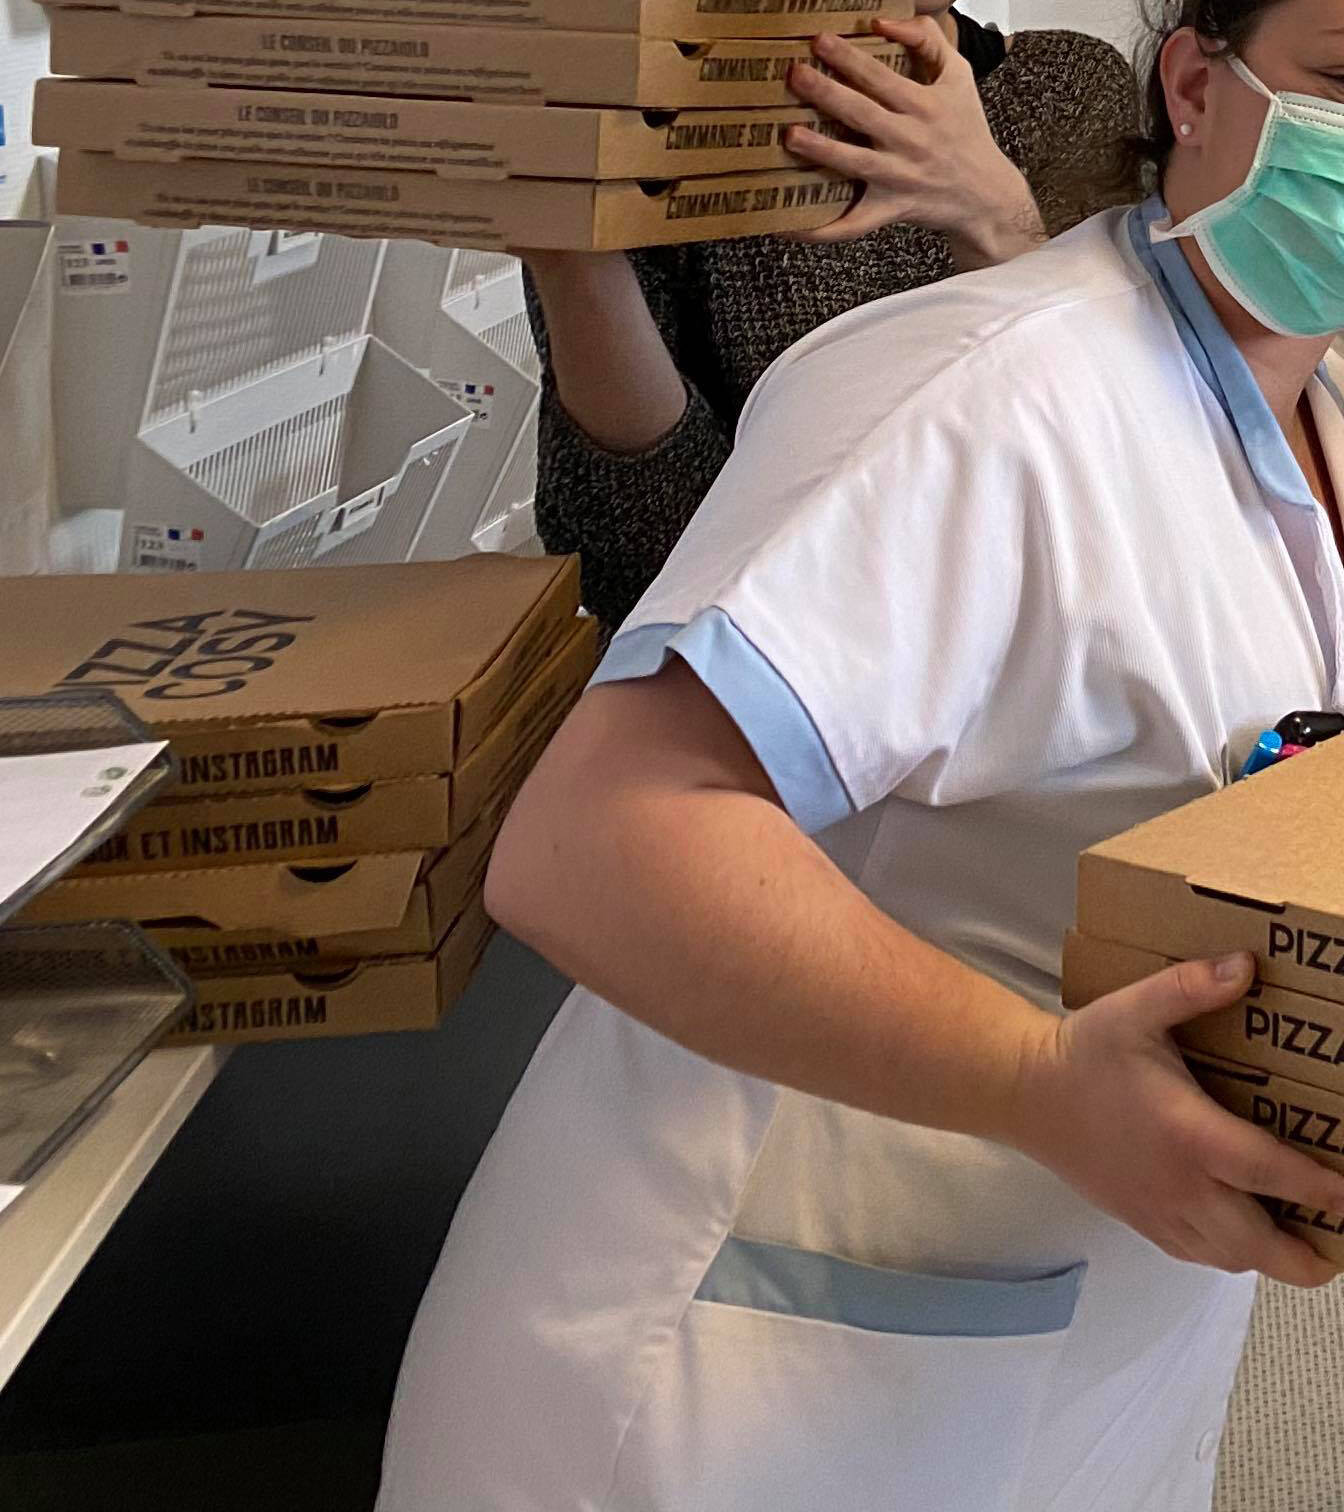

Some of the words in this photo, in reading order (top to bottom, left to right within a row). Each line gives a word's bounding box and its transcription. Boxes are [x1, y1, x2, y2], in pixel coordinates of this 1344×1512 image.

[700, 57, 770, 82] COMMANDE
[666, 124, 747, 150] COMMANDE
[748, 123, 774, 147] SUR
[666, 191, 750, 220] COMMANDE
[752, 186, 778, 210] SUR
[143, 609, 317, 699] COSY
[180, 742, 339, 785] INSTAGRAM
[141, 830, 172, 861] ET
[181, 814, 339, 857] INSTAGRAM
